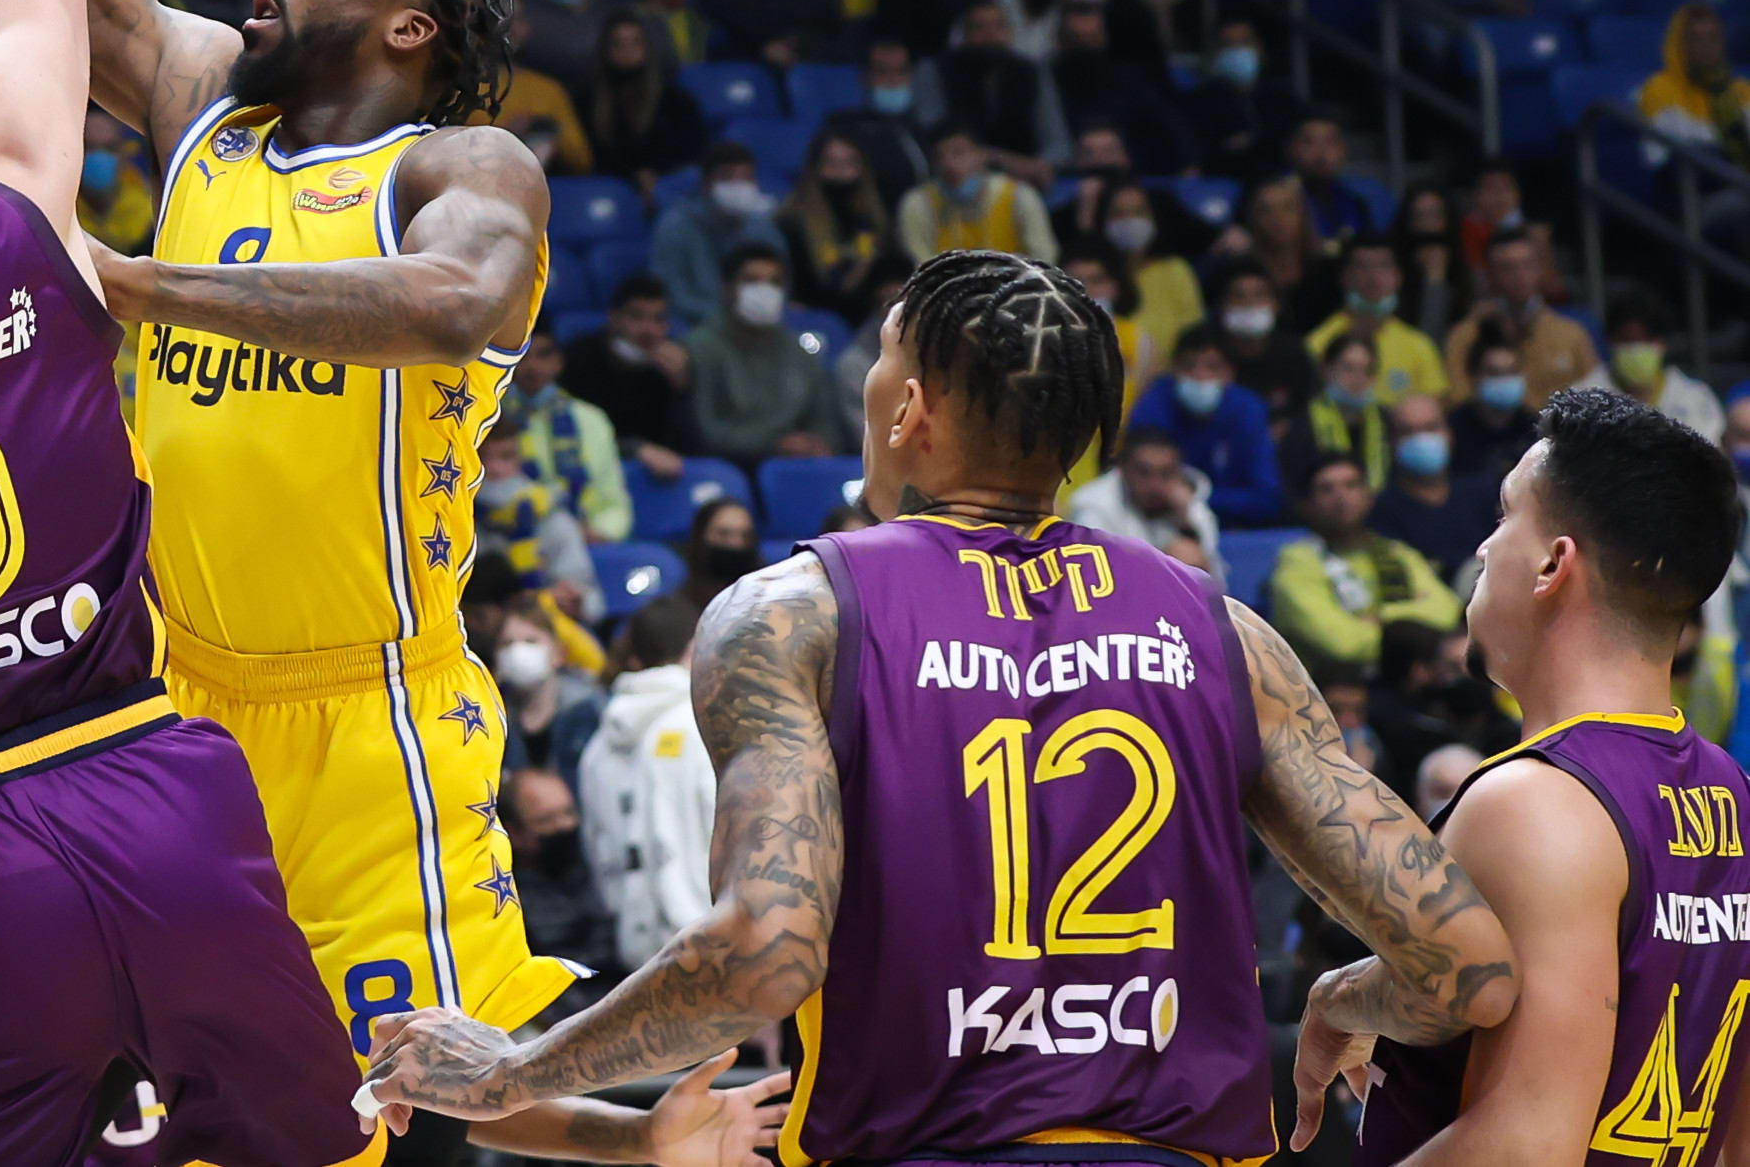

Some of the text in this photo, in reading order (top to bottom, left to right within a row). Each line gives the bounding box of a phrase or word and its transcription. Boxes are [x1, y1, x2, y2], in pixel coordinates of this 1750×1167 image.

[916, 634, 1186, 700] AUTO CENTER
[963, 709, 1176, 960] 12
[948, 976, 1179, 1058] KASCO
